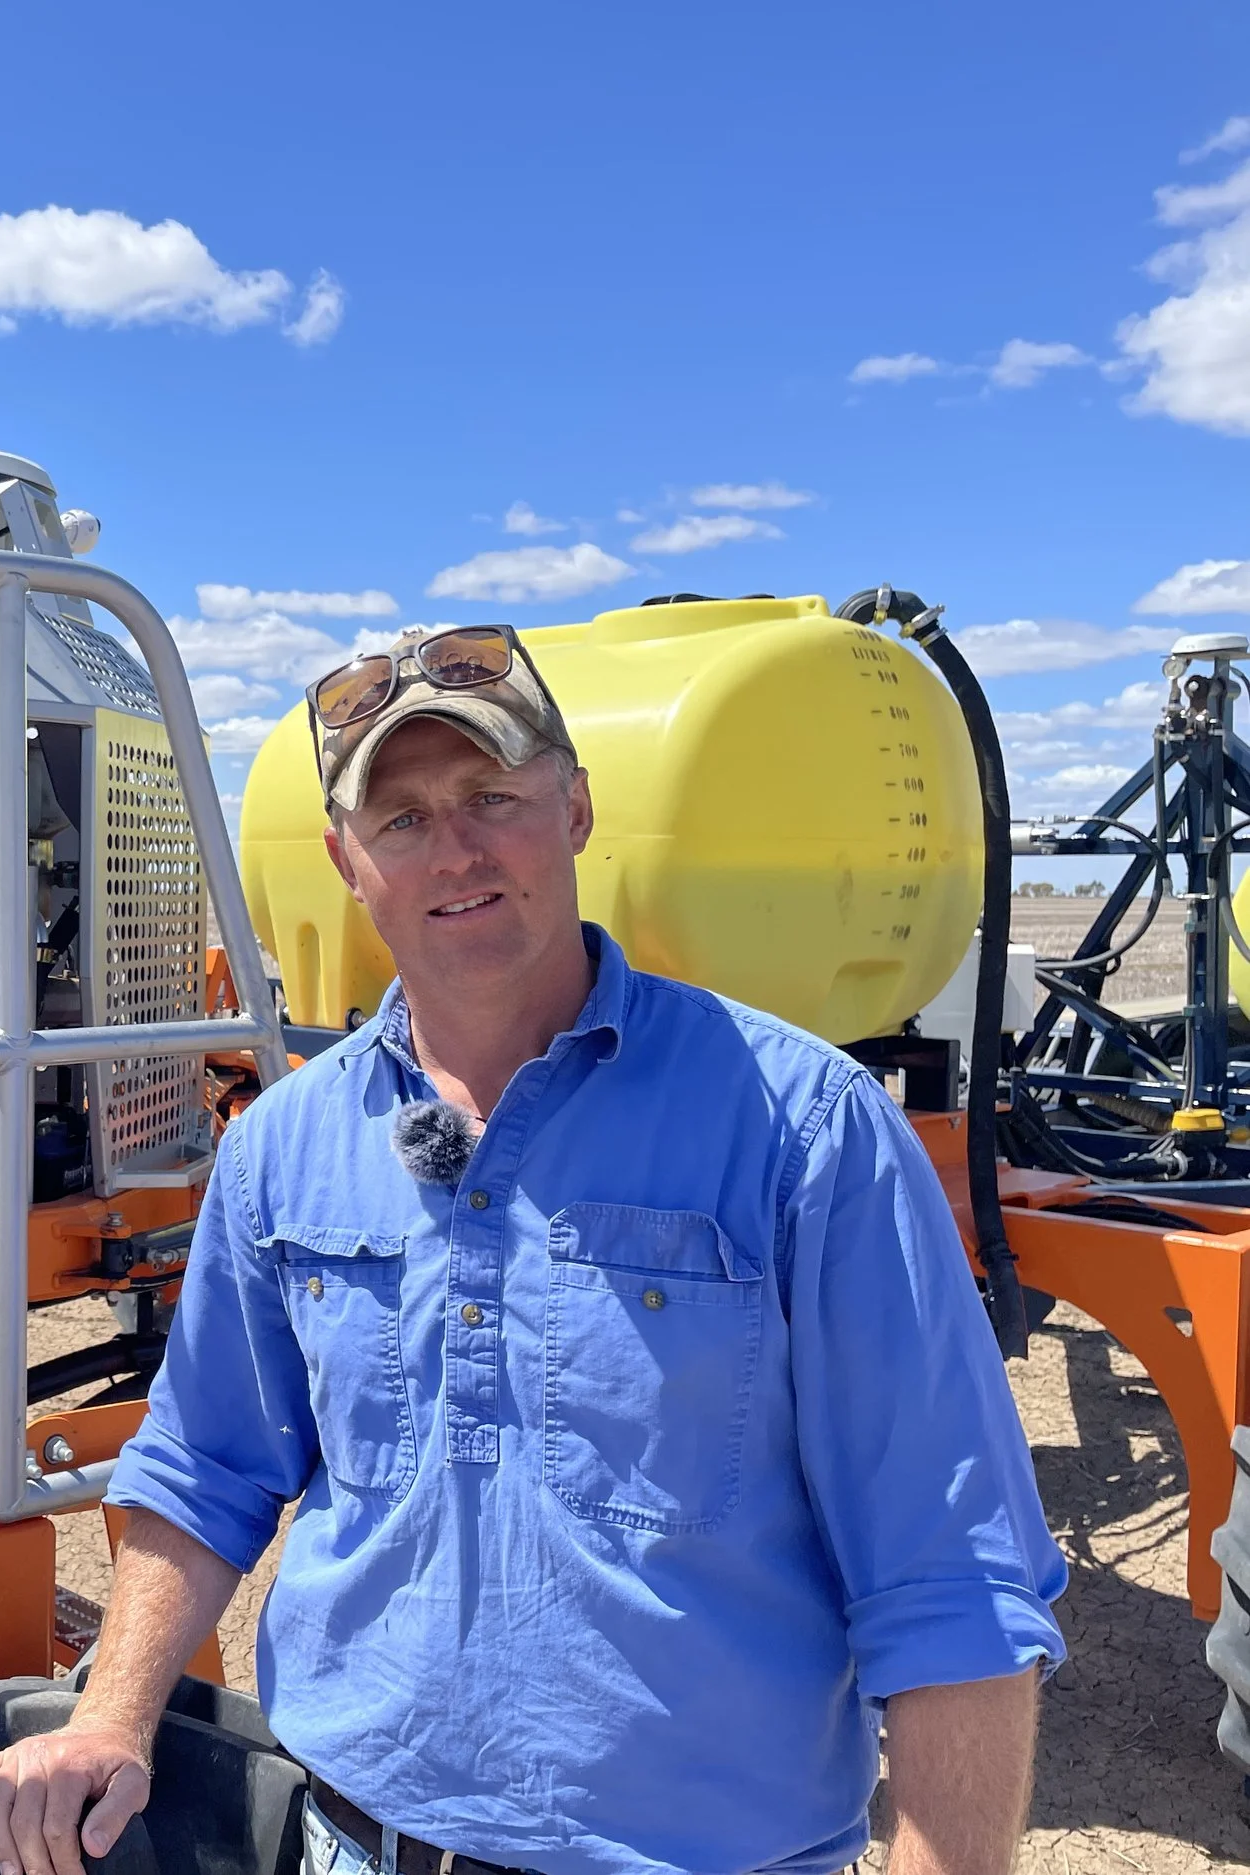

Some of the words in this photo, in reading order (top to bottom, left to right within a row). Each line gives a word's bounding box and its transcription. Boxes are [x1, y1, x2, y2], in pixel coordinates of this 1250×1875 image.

[852, 646, 890, 662] LITRES
[889, 705, 910, 720] 800
[898, 742, 919, 758] 700
[903, 777, 924, 792] 600
[909, 812, 928, 827] 500
[906, 847, 926, 863] 400
[899, 884, 921, 900] 300
[890, 924, 911, 941] 200
